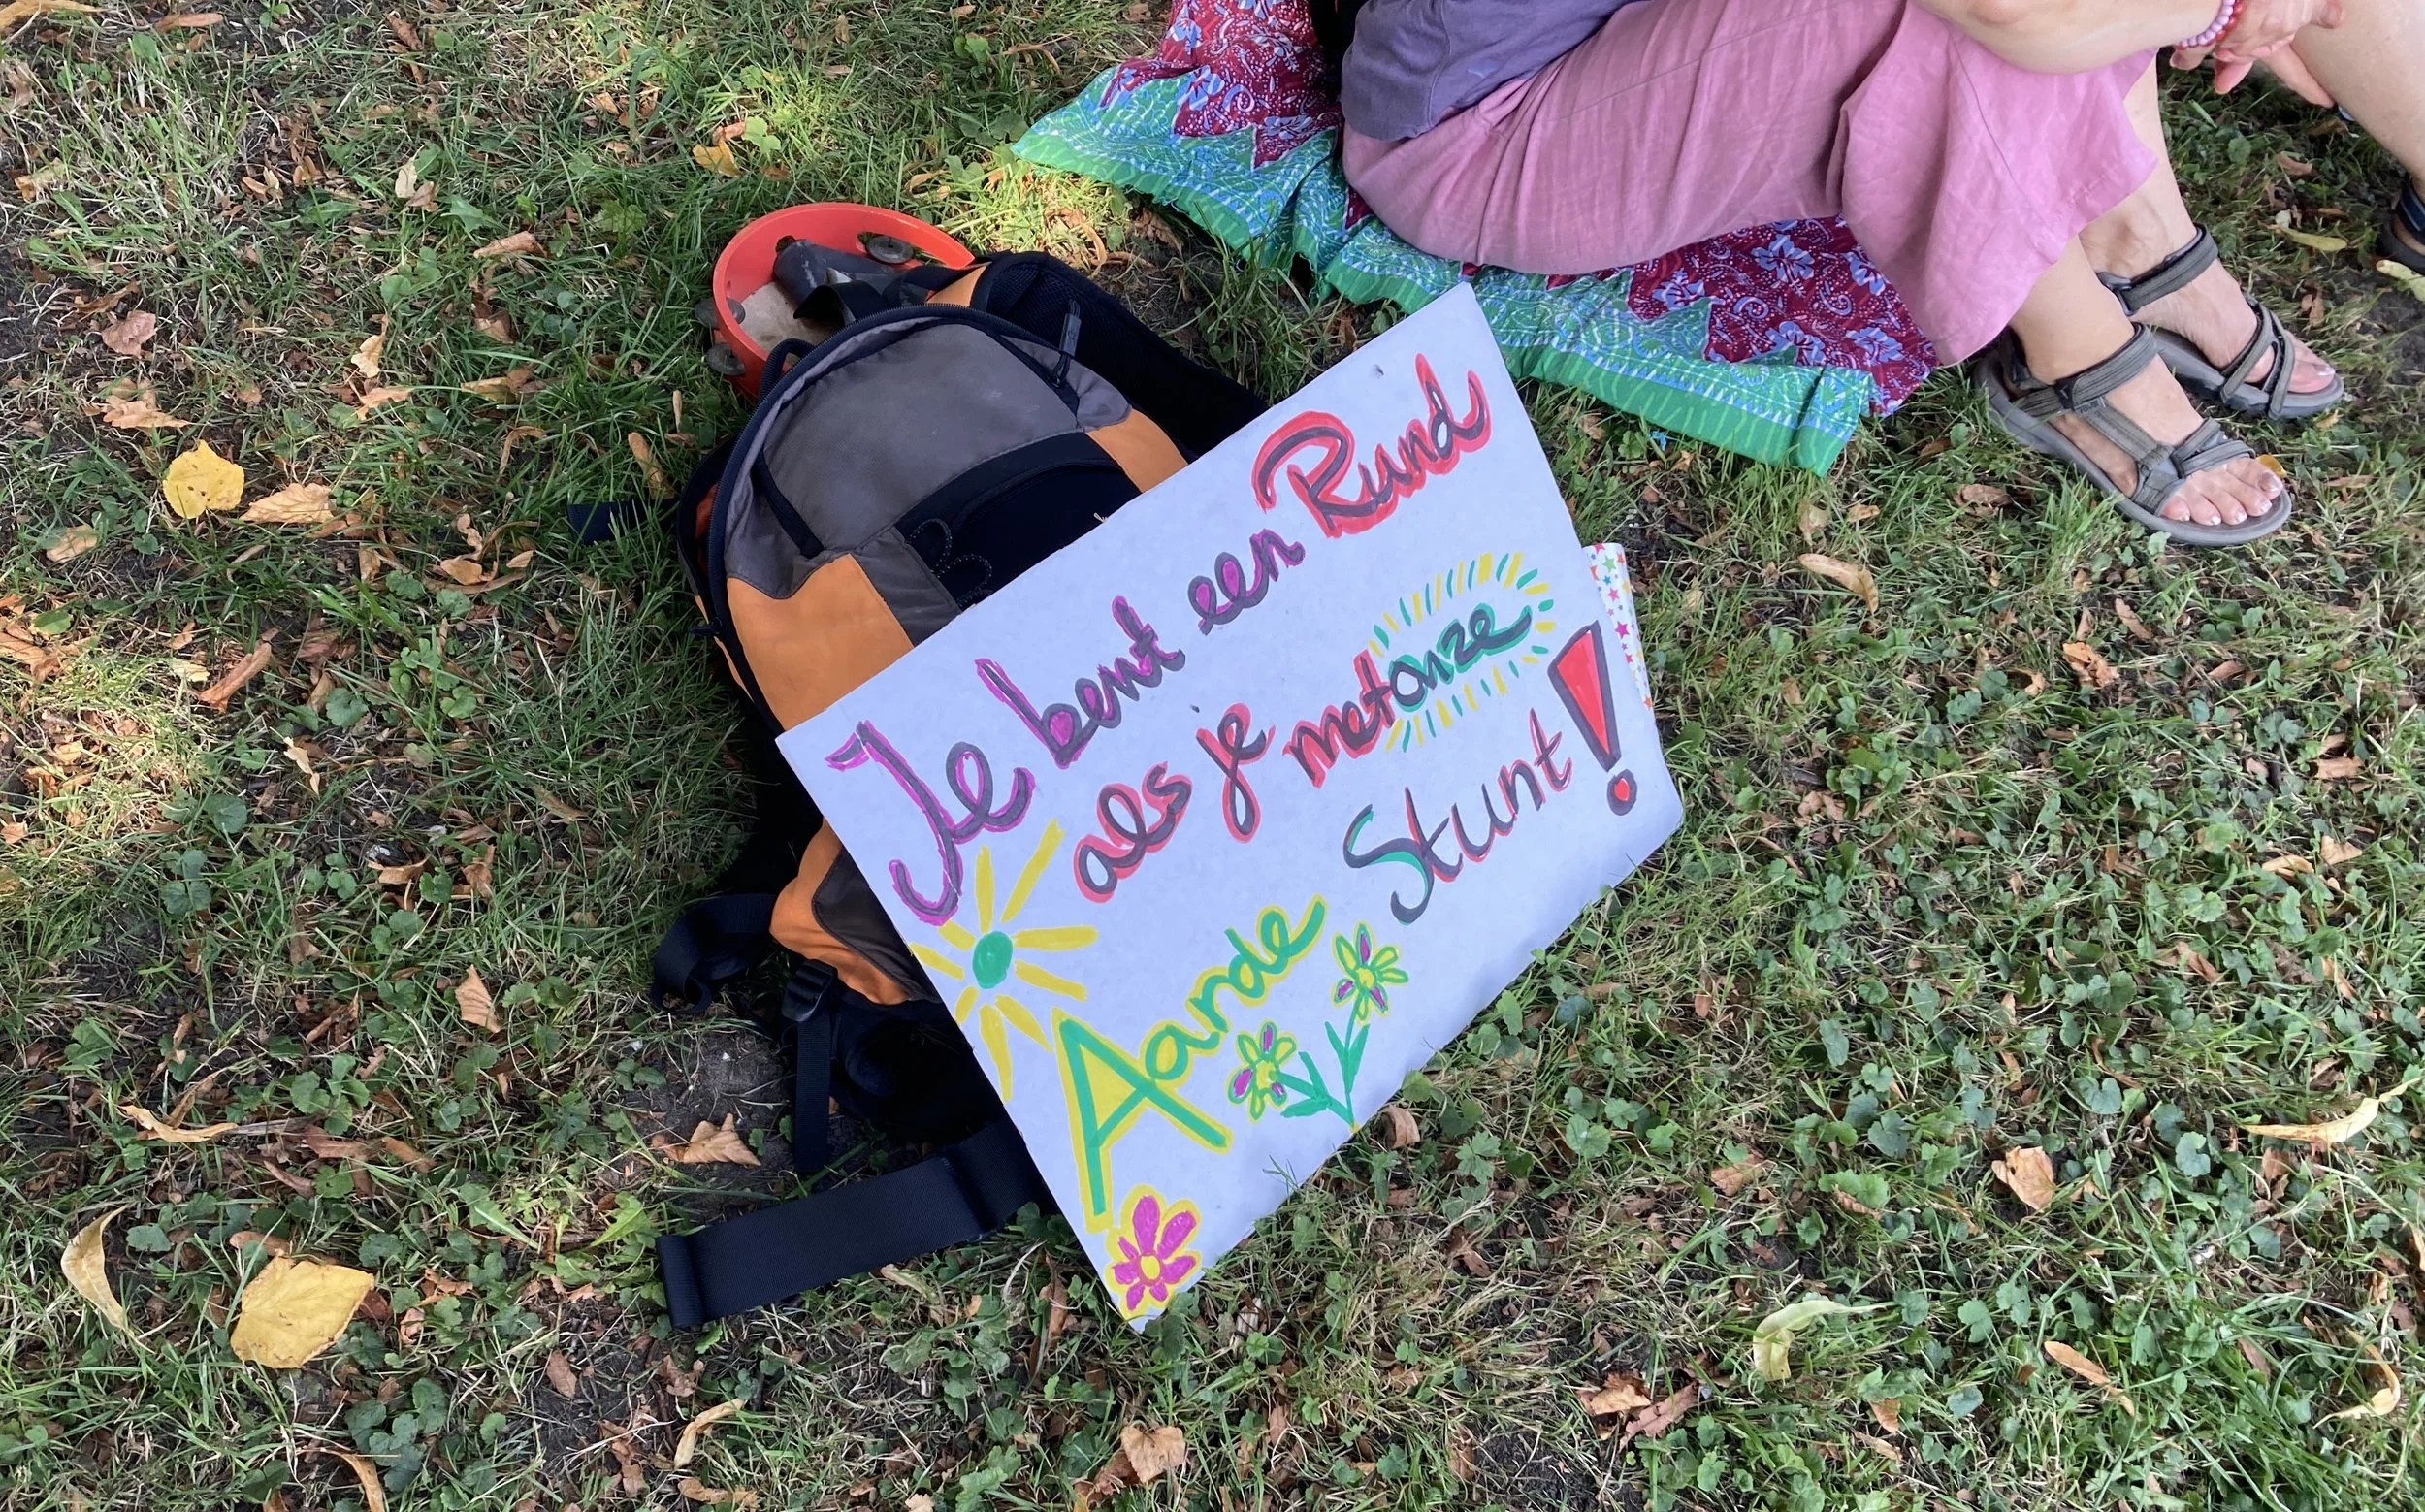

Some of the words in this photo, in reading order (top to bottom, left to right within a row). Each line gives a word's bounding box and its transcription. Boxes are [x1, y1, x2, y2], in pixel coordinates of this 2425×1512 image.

[824, 720, 1036, 927] Je
[975, 595, 1186, 770] bent
[1187, 528, 1306, 636] een
[1251, 353, 1492, 538] Rund
[1073, 761, 1193, 904] als
[1196, 702, 1277, 844] je
[1282, 649, 1396, 789] met
[1388, 602, 1533, 712] onze
